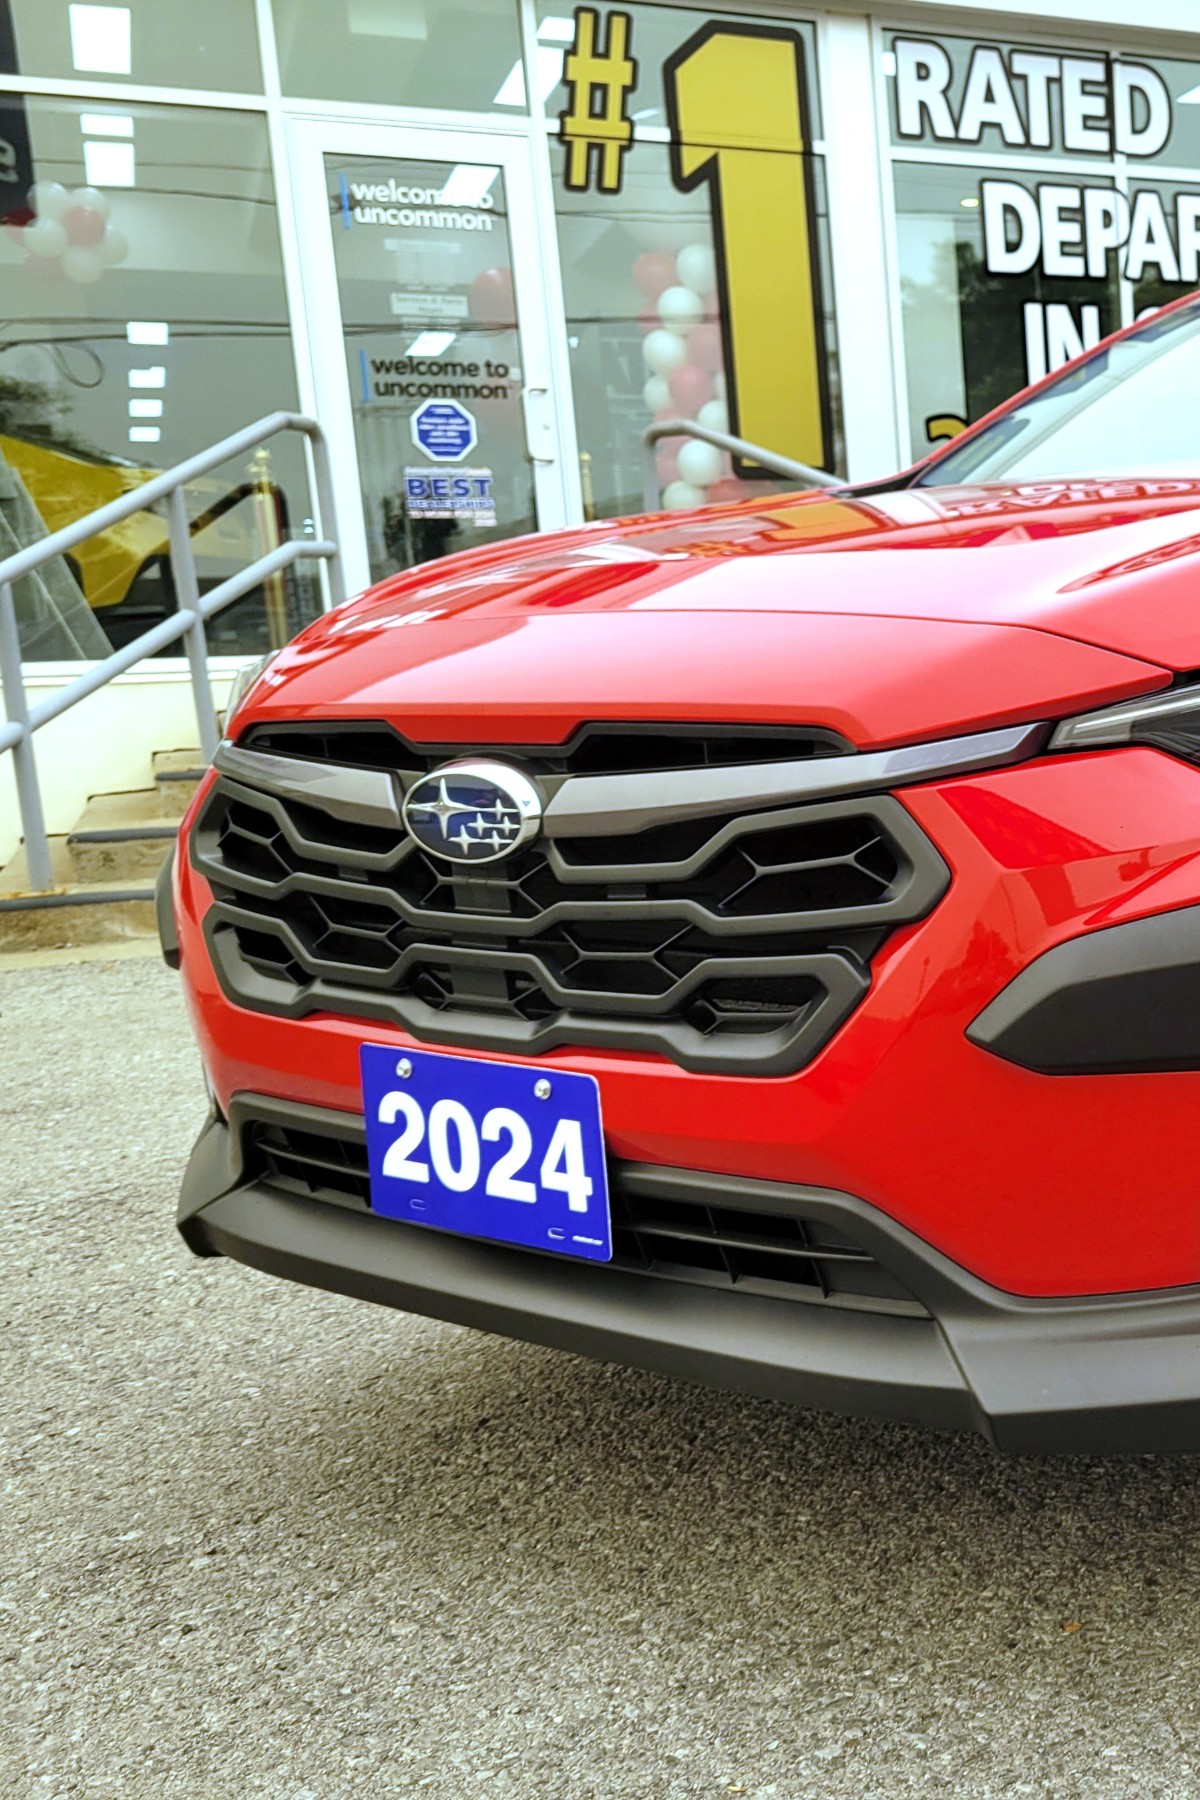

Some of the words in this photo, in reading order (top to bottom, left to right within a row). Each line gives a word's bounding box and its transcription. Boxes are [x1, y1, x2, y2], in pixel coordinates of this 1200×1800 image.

[893, 38, 1171, 157] RATED
[350, 178, 464, 207] welcom
[354, 206, 493, 232] uncommon
[561, 7, 834, 478] #1
[1022, 301, 1101, 387] IN
[371, 355, 480, 377] welcome
[484, 359, 509, 378] to
[374, 381, 508, 399] uncommon
[406, 477, 491, 497] BEST
[378, 1090, 594, 1214] 2024
